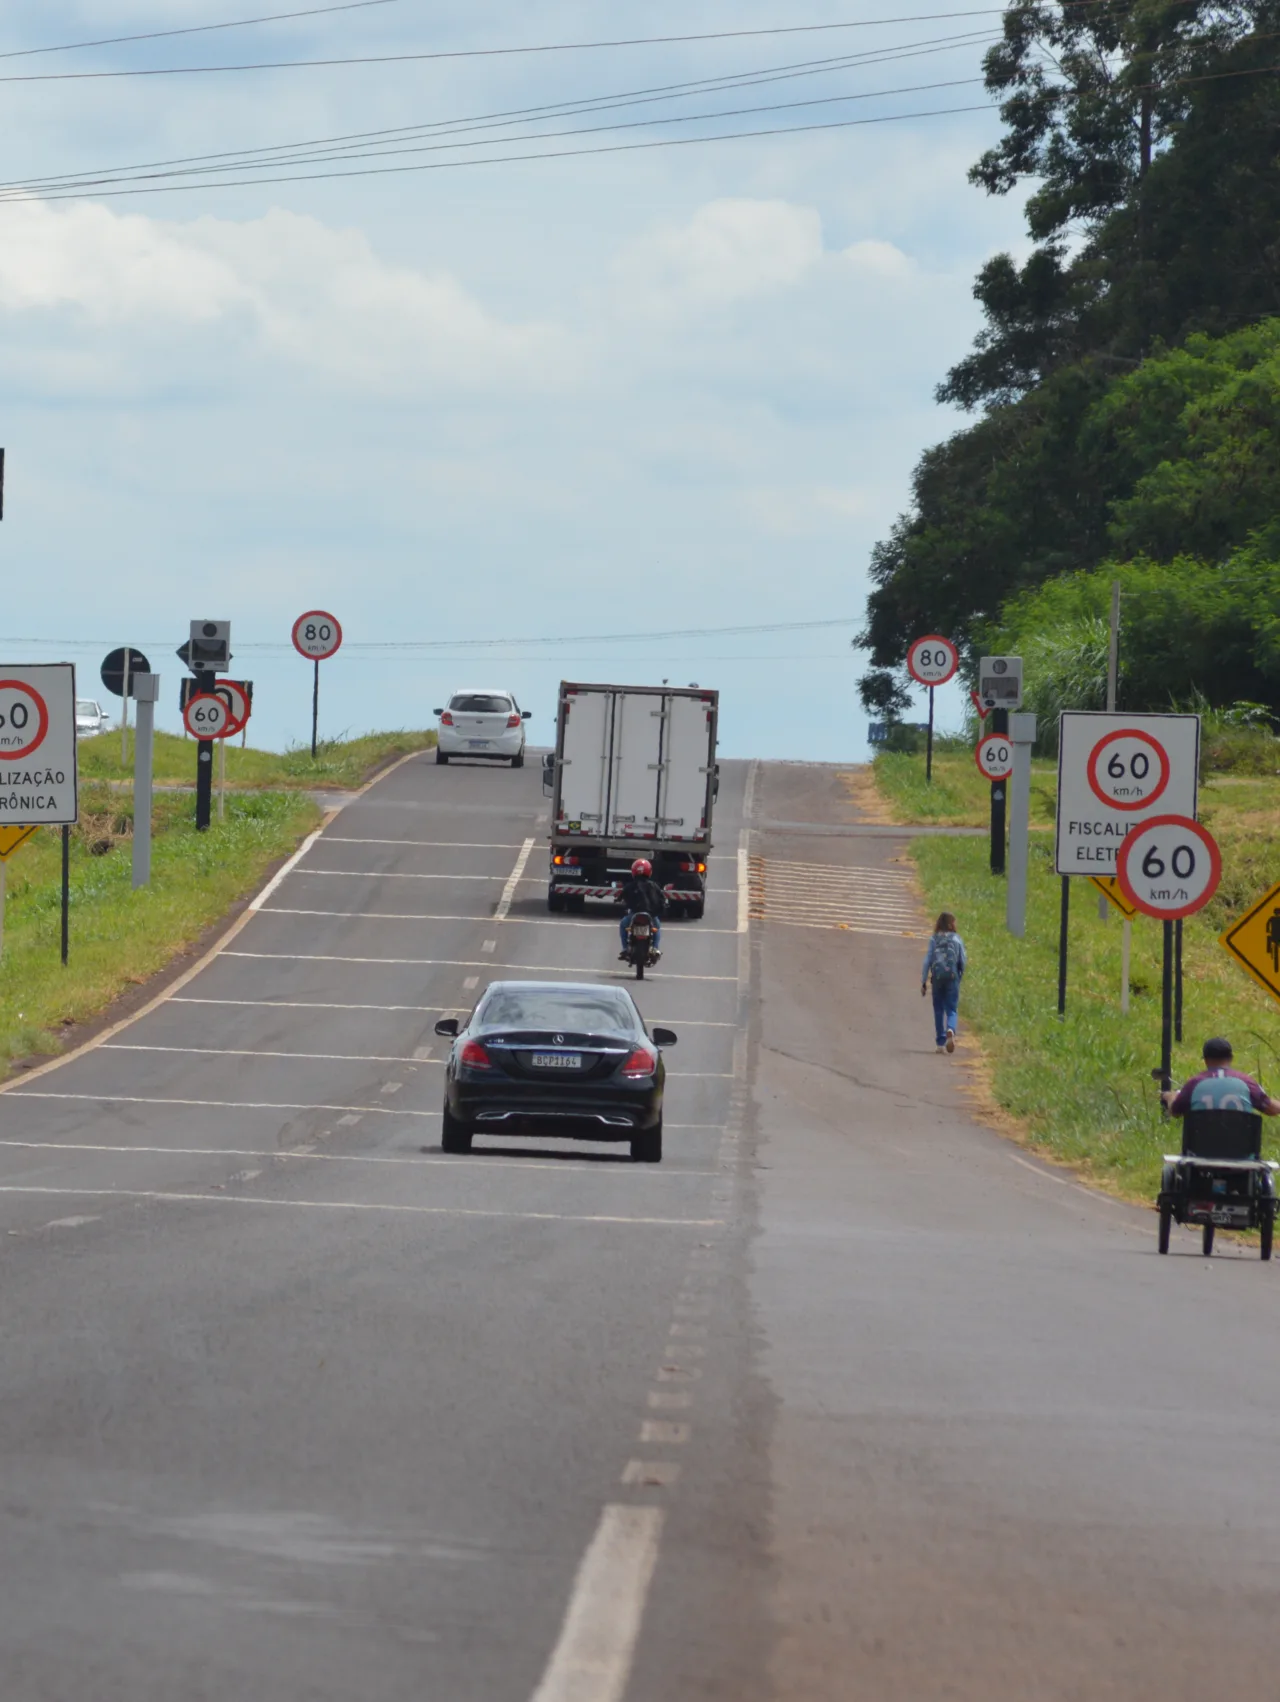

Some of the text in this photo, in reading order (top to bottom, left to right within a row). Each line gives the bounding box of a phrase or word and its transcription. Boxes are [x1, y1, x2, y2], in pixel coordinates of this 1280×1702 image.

[304, 624, 331, 641] 80
[308, 644, 327, 652] km/h
[920, 649, 947, 667] 80
[194, 706, 220, 723] 60
[197, 725, 216, 733] km/h
[985, 746, 1009, 763] 60
[1107, 752, 1150, 780] 60
[1113, 786, 1144, 797] km/h
[1068, 821, 1138, 837] FISCALI
[1141, 844, 1196, 879] 60
[1149, 888, 1188, 901] km/h
